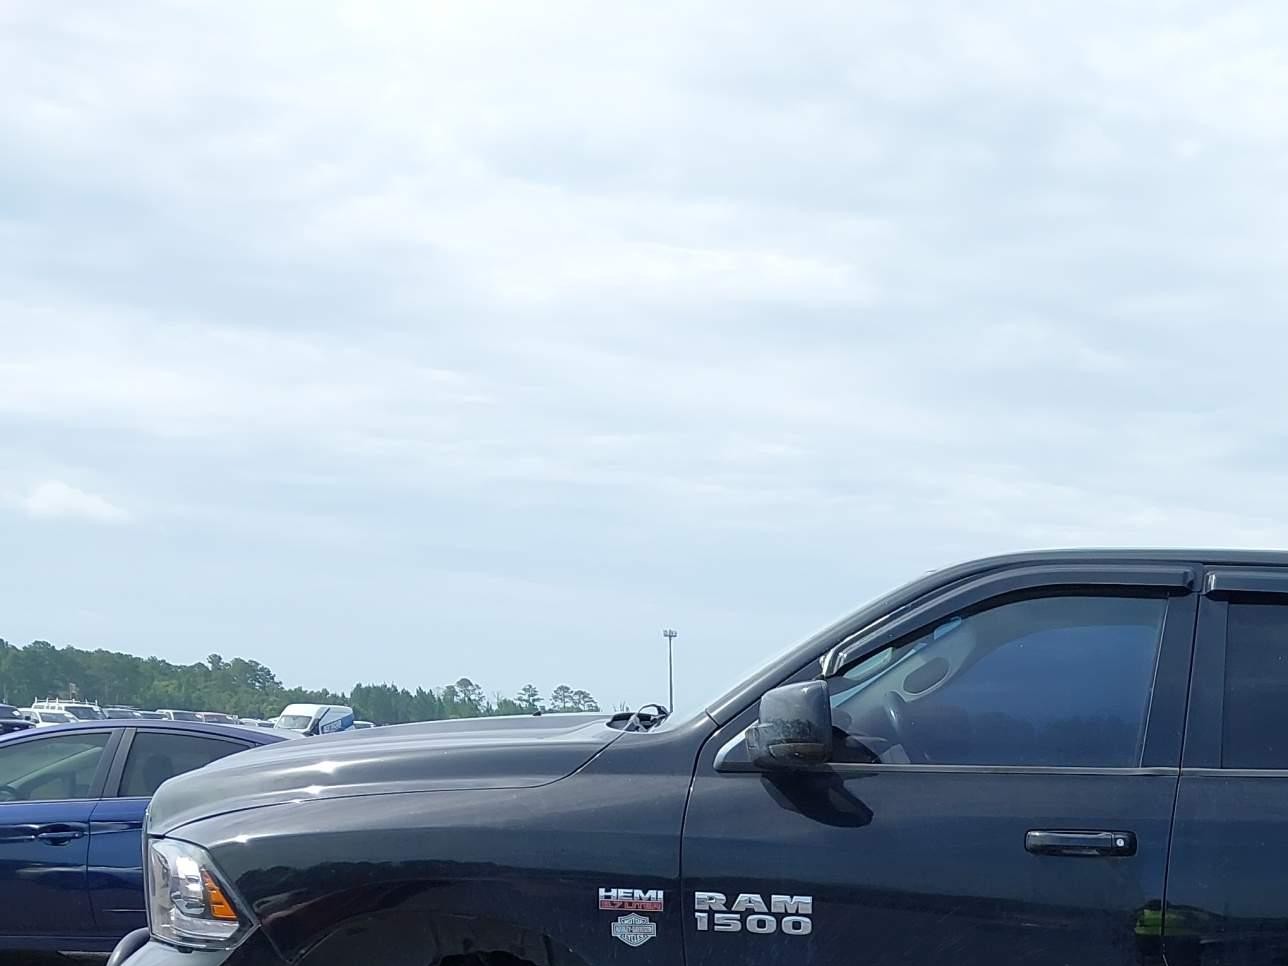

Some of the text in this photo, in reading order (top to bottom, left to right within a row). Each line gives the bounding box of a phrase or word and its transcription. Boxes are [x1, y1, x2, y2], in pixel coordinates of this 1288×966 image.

[599, 887, 664, 901] HEMI
[695, 891, 812, 914] RAM
[695, 912, 812, 935] 1500
